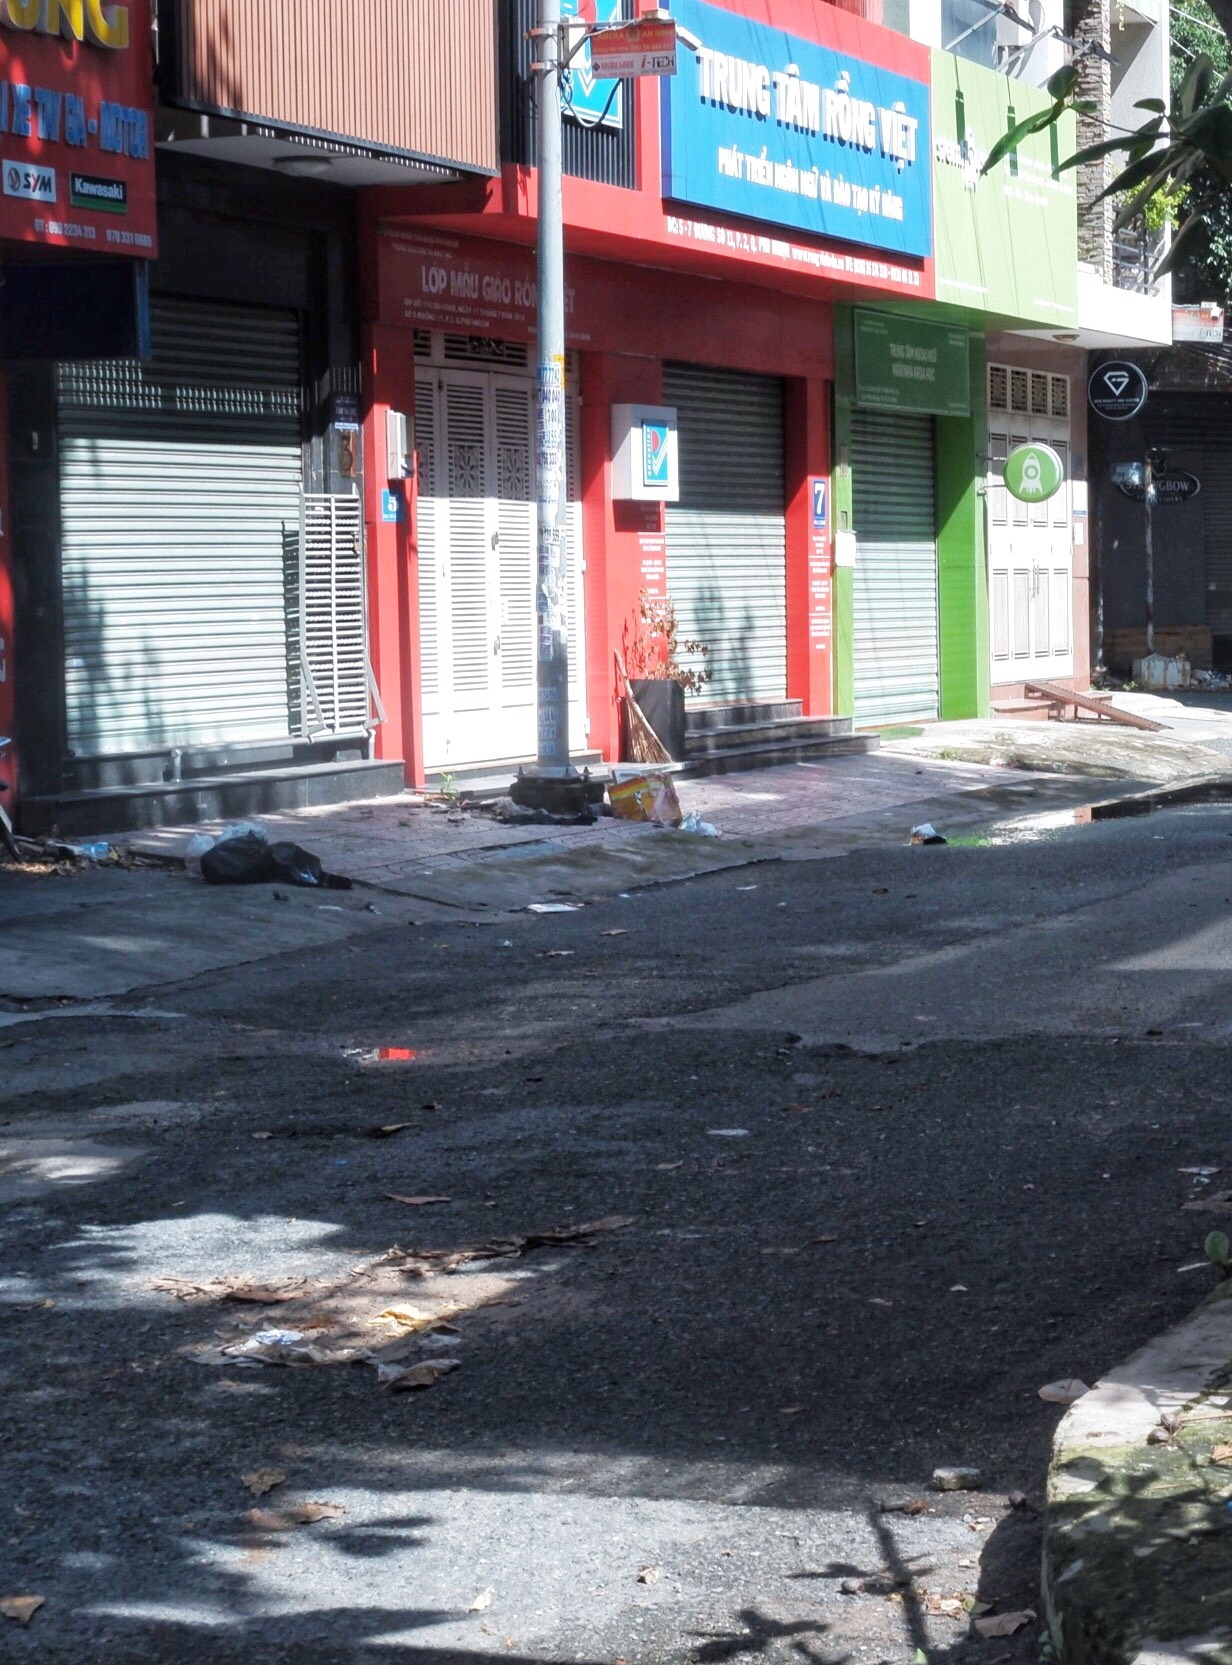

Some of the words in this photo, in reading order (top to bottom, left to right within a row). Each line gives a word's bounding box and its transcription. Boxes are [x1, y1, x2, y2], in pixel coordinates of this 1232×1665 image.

[696, 47, 770, 117] TRUNG
[773, 64, 820, 132] TÂM
[823, 70, 876, 148] RỒNG
[878, 101, 918, 169] VIỆT
[23, 172, 52, 194] SYM
[74, 177, 124, 200] Kawasaki
[717, 144, 743, 179] PHÁT
[745, 146, 773, 187] TRIỂN
[820, 170, 832, 202] VÀ
[851, 183, 868, 216] TẠO
[422, 262, 447, 295] LỚP
[482, 271, 511, 304] GIÁO
[815, 483, 825, 514] 7
